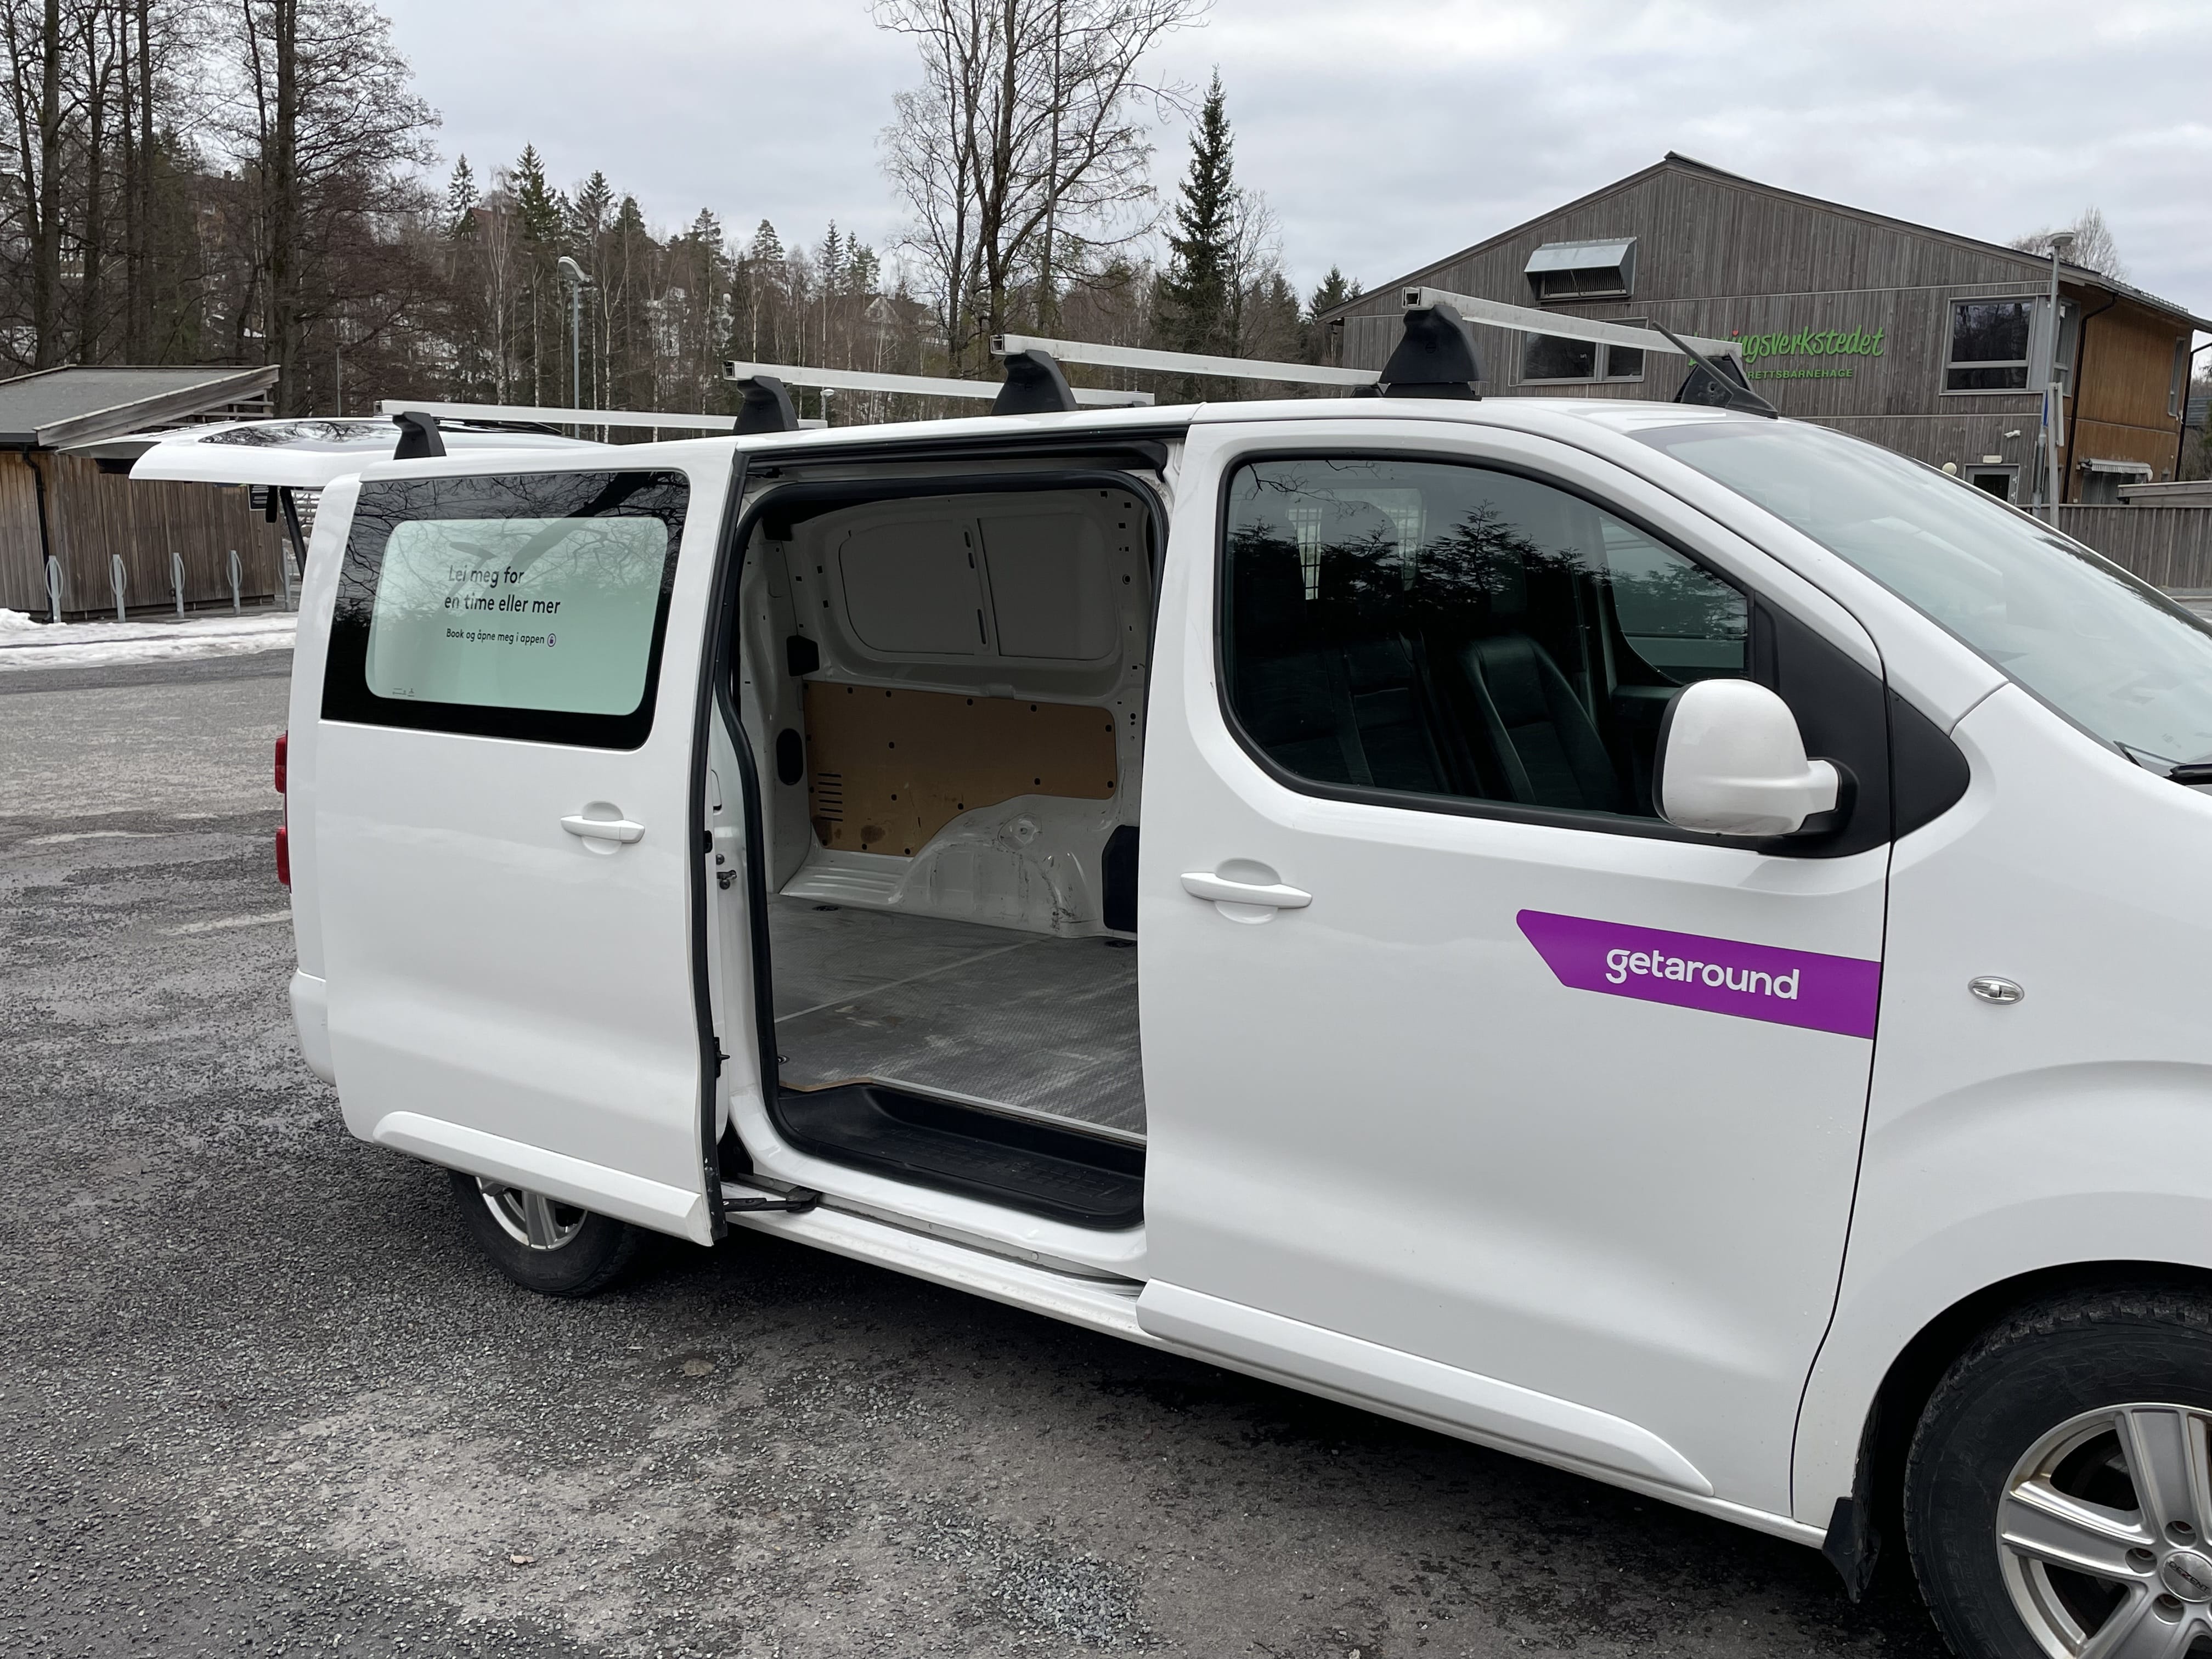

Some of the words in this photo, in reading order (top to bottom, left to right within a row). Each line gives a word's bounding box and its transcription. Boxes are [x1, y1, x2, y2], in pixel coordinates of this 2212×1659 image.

[1747, 369, 1853, 380] RETTSBARNEHAGE
[448, 565, 467, 582] Lei
[470, 569, 499, 588] meg
[504, 566, 524, 584] for
[444, 596, 460, 609] en
[464, 592, 494, 611] time
[499, 594, 528, 612] eller
[532, 600, 561, 614] mer
[446, 628, 464, 638] Book
[466, 632, 475, 642] og
[477, 629, 495, 642] åpne
[497, 633, 514, 645] meg
[516, 631, 519, 642] i
[520, 635, 545, 646] appen
[1605, 949, 1800, 1000] getaround
[2169, 1560, 2208, 1592] DEZENT
